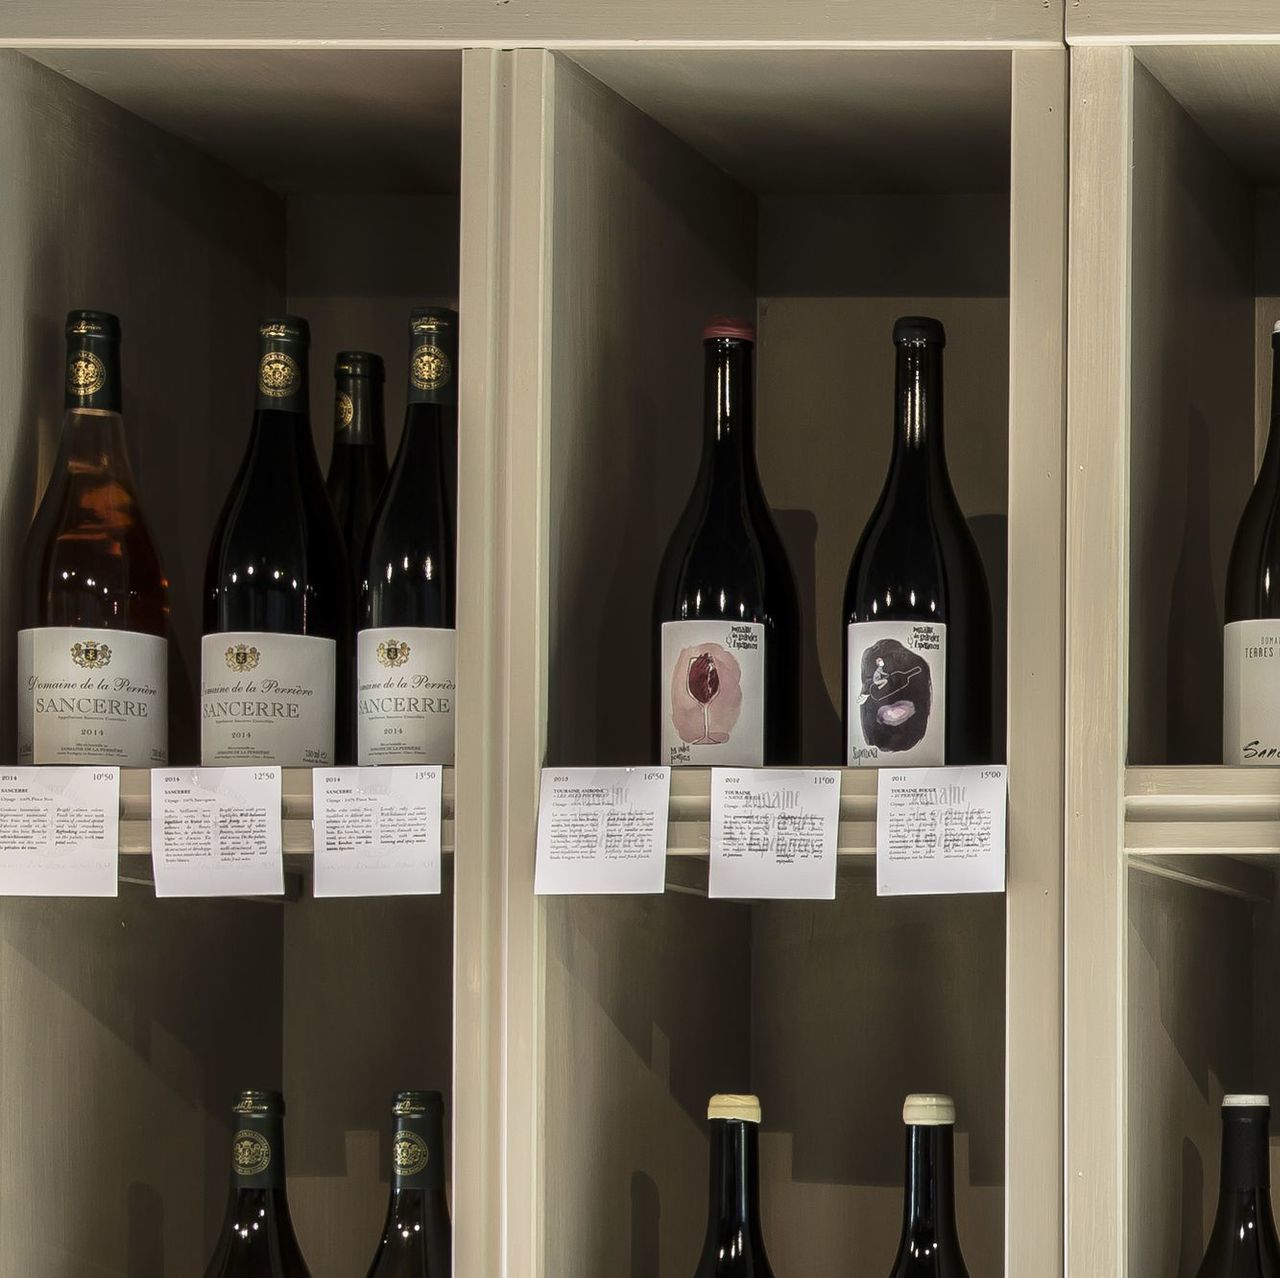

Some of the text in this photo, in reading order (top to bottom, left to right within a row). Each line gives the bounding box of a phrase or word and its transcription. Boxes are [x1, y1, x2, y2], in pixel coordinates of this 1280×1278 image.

[1244, 647, 1275, 659] TERRES
[80, 677, 96, 690] de
[98, 677, 110, 690] la
[35, 697, 149, 719] SANCERRE
[204, 701, 300, 719] SANCERRE
